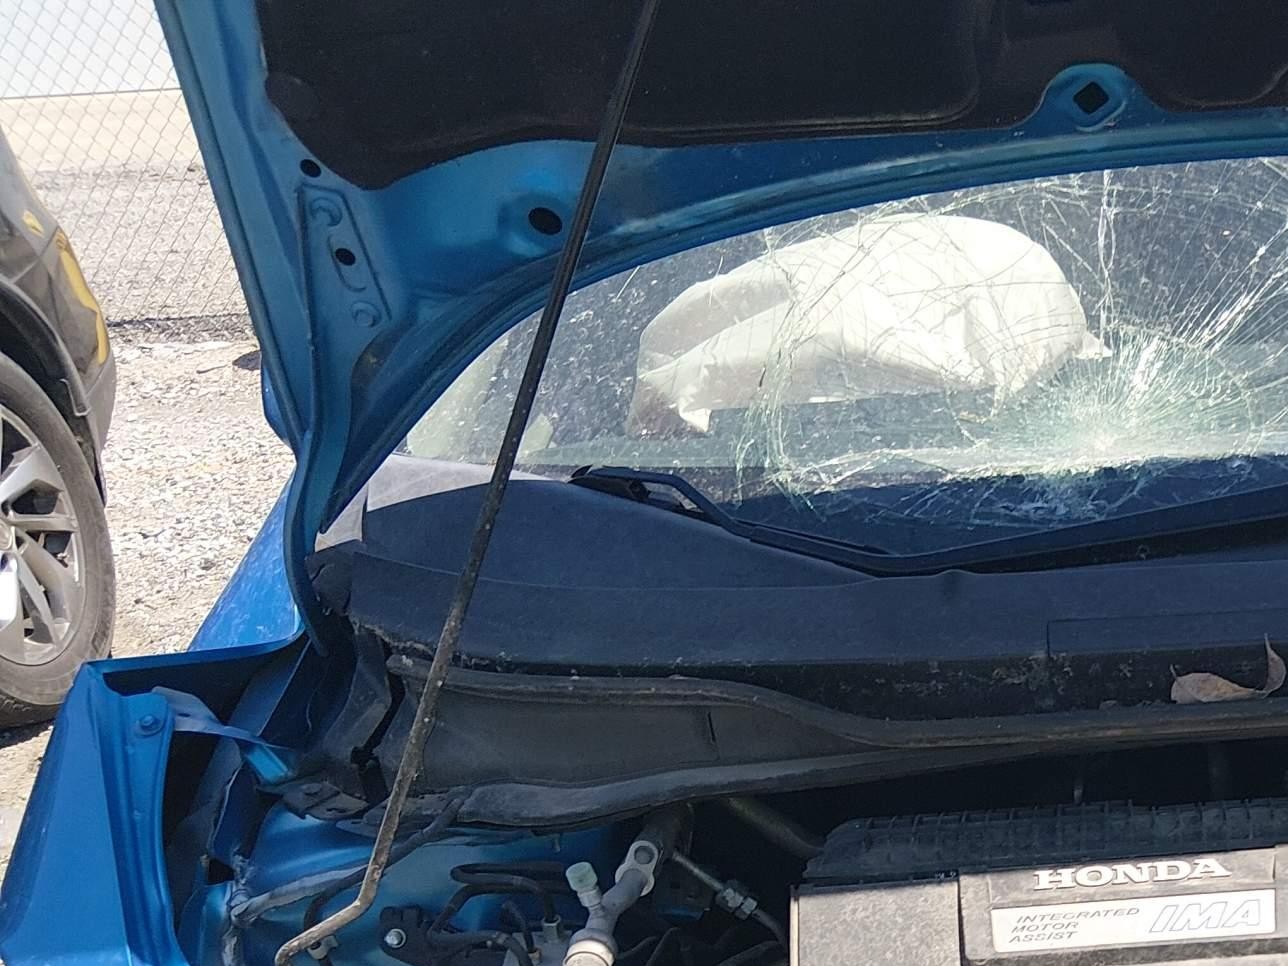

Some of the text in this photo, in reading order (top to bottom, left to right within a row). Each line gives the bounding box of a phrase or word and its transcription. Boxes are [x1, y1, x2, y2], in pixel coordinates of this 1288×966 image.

[1034, 859, 1232, 890] HONDA
[1016, 907, 1141, 924] INTEGRATED
[1149, 899, 1262, 933] IMA
[1011, 922, 1080, 934] MOTOR
[1008, 931, 1079, 944] ASSIST
